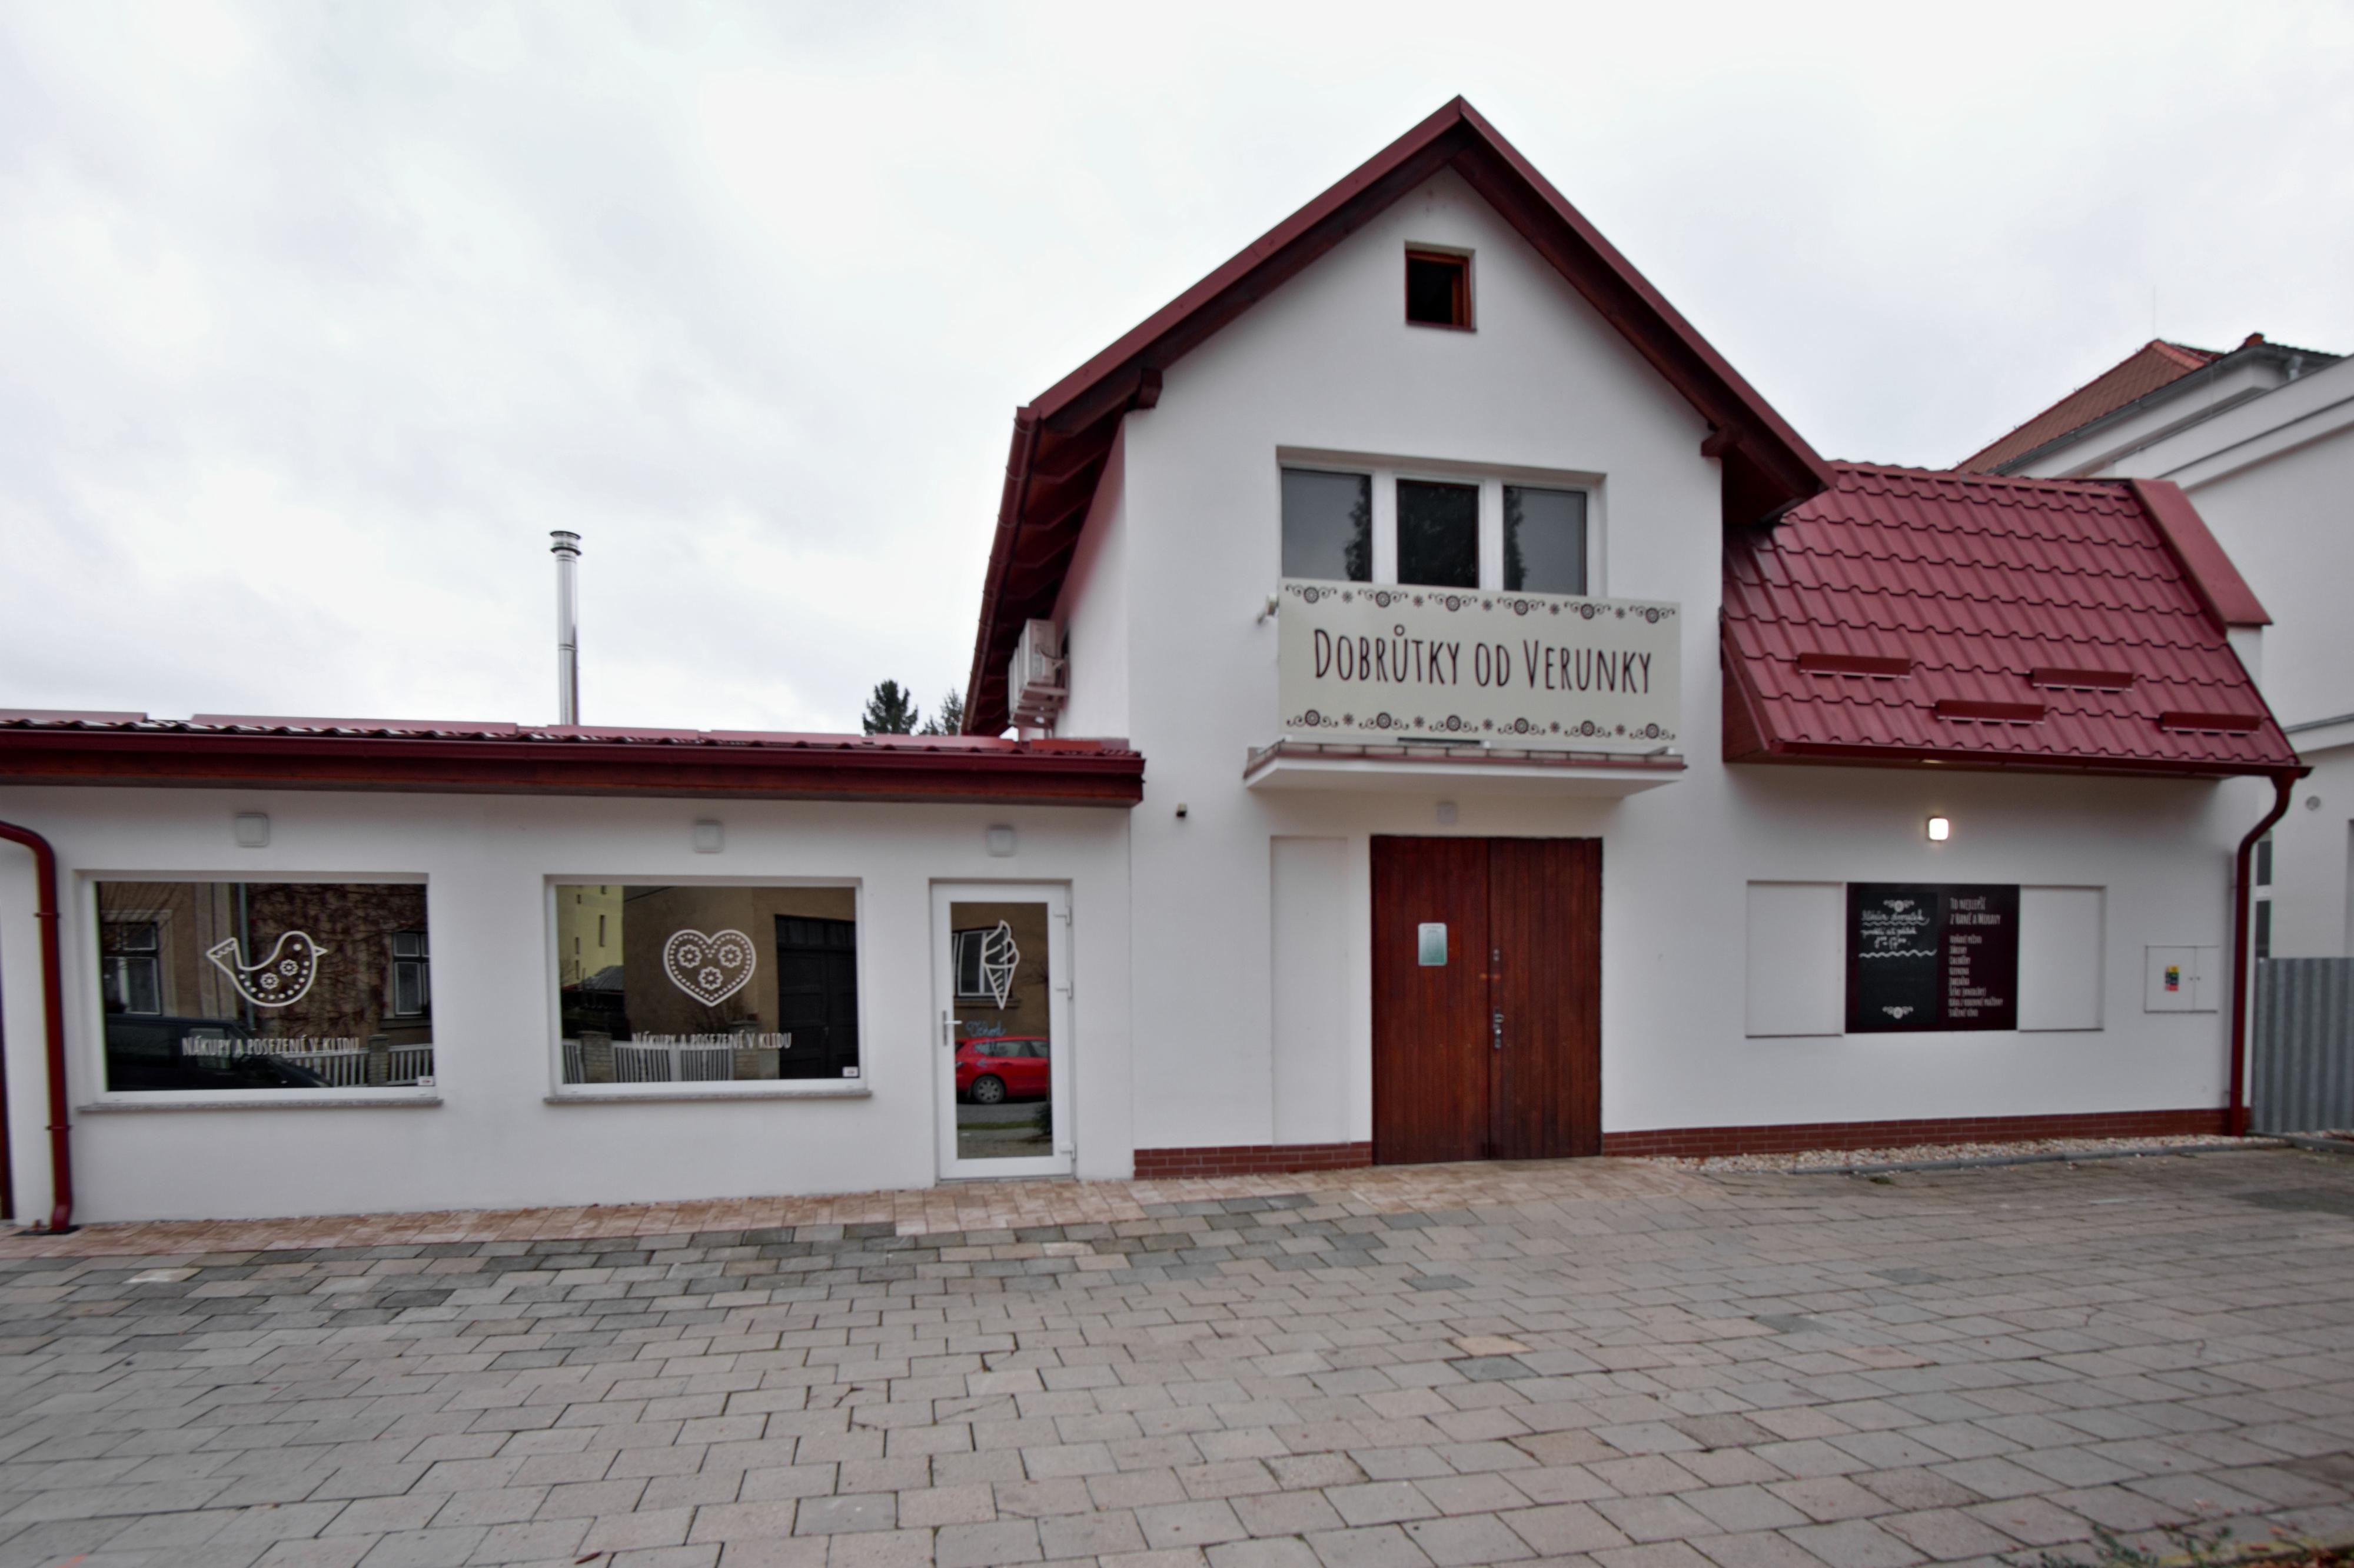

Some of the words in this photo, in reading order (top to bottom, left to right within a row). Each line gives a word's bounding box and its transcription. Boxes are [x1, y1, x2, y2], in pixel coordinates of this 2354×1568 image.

[1314, 624, 1460, 685] DOBRŮTKY
[1475, 642, 1511, 687] OD
[1523, 640, 1652, 694] VERUNKY
[182, 1036, 231, 1056] NÁKUPY
[235, 1038, 244, 1055] A
[246, 1034, 308, 1055] POSEZENÍ
[309, 1037, 319, 1053] V
[322, 1037, 360, 1053] KLIDU
[631, 1031, 676, 1049] NÁKUPY
[680, 1033, 688, 1049] A
[690, 1030, 744, 1049] POSEZENÍ
[746, 1033, 756, 1049] V
[757, 1031, 792, 1049] KLIDU
